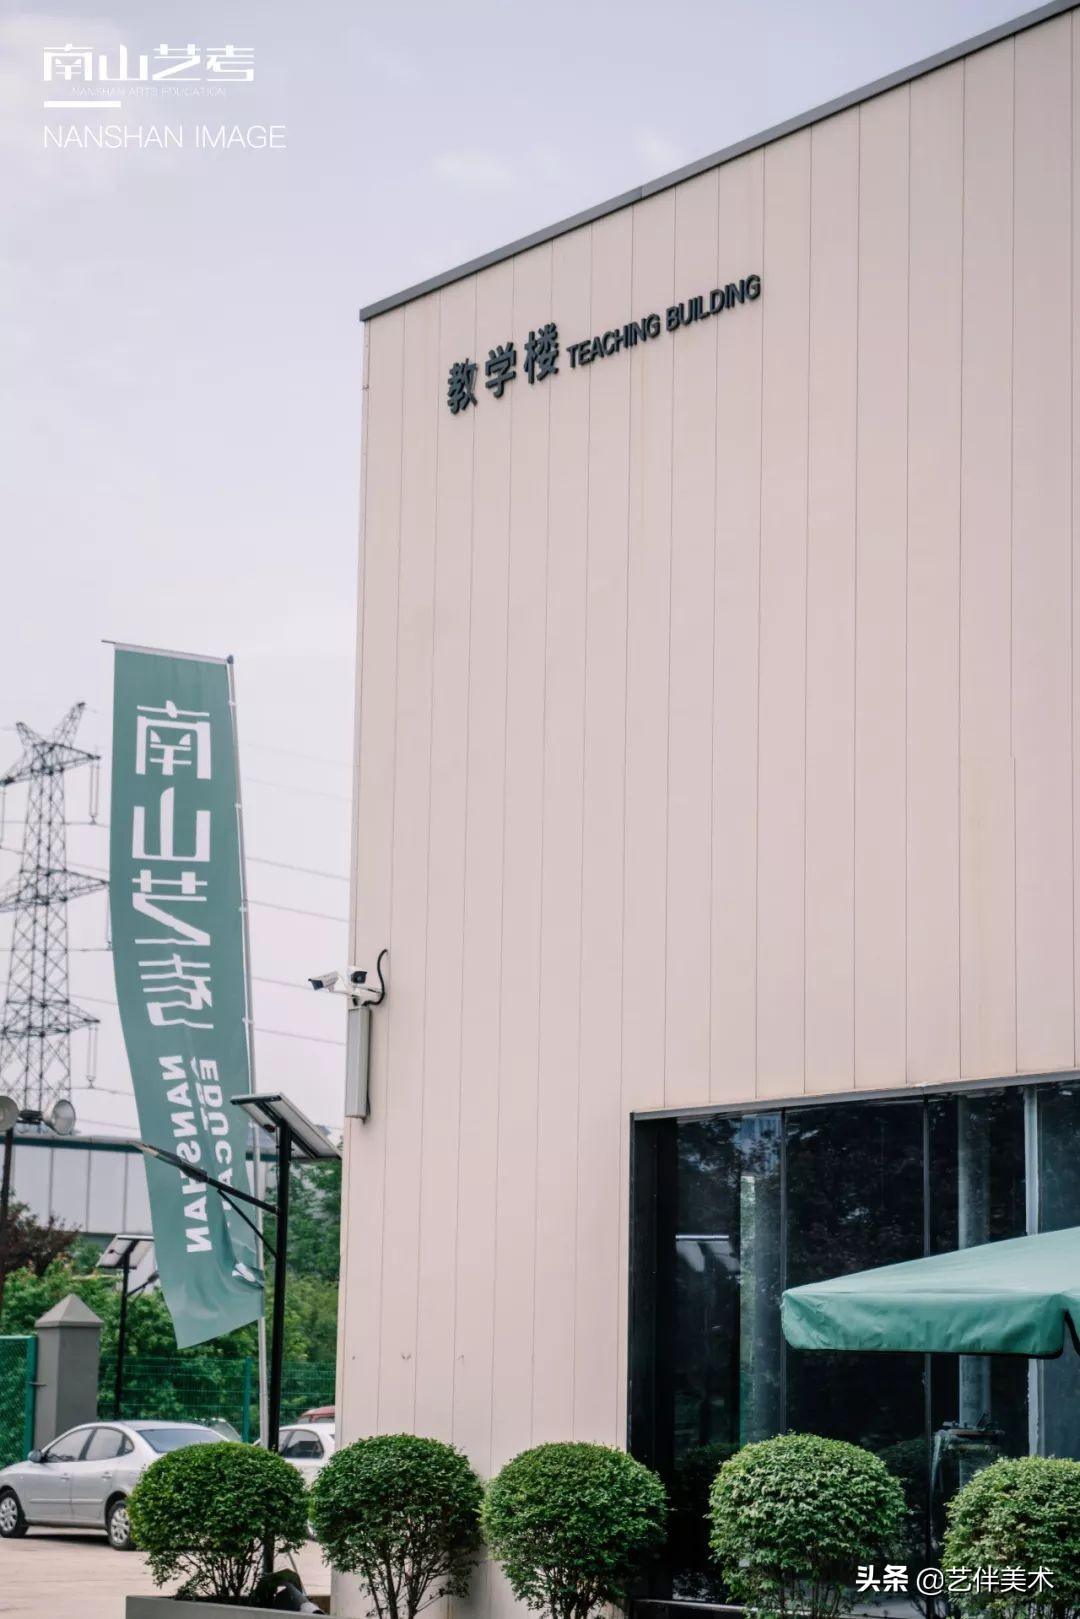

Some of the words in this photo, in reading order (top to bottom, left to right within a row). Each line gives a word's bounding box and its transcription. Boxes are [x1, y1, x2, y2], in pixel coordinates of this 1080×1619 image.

[447, 322, 560, 415] 教学楼
[566, 313, 661, 369] TEACHING
[666, 274, 761, 332] BUILDING
